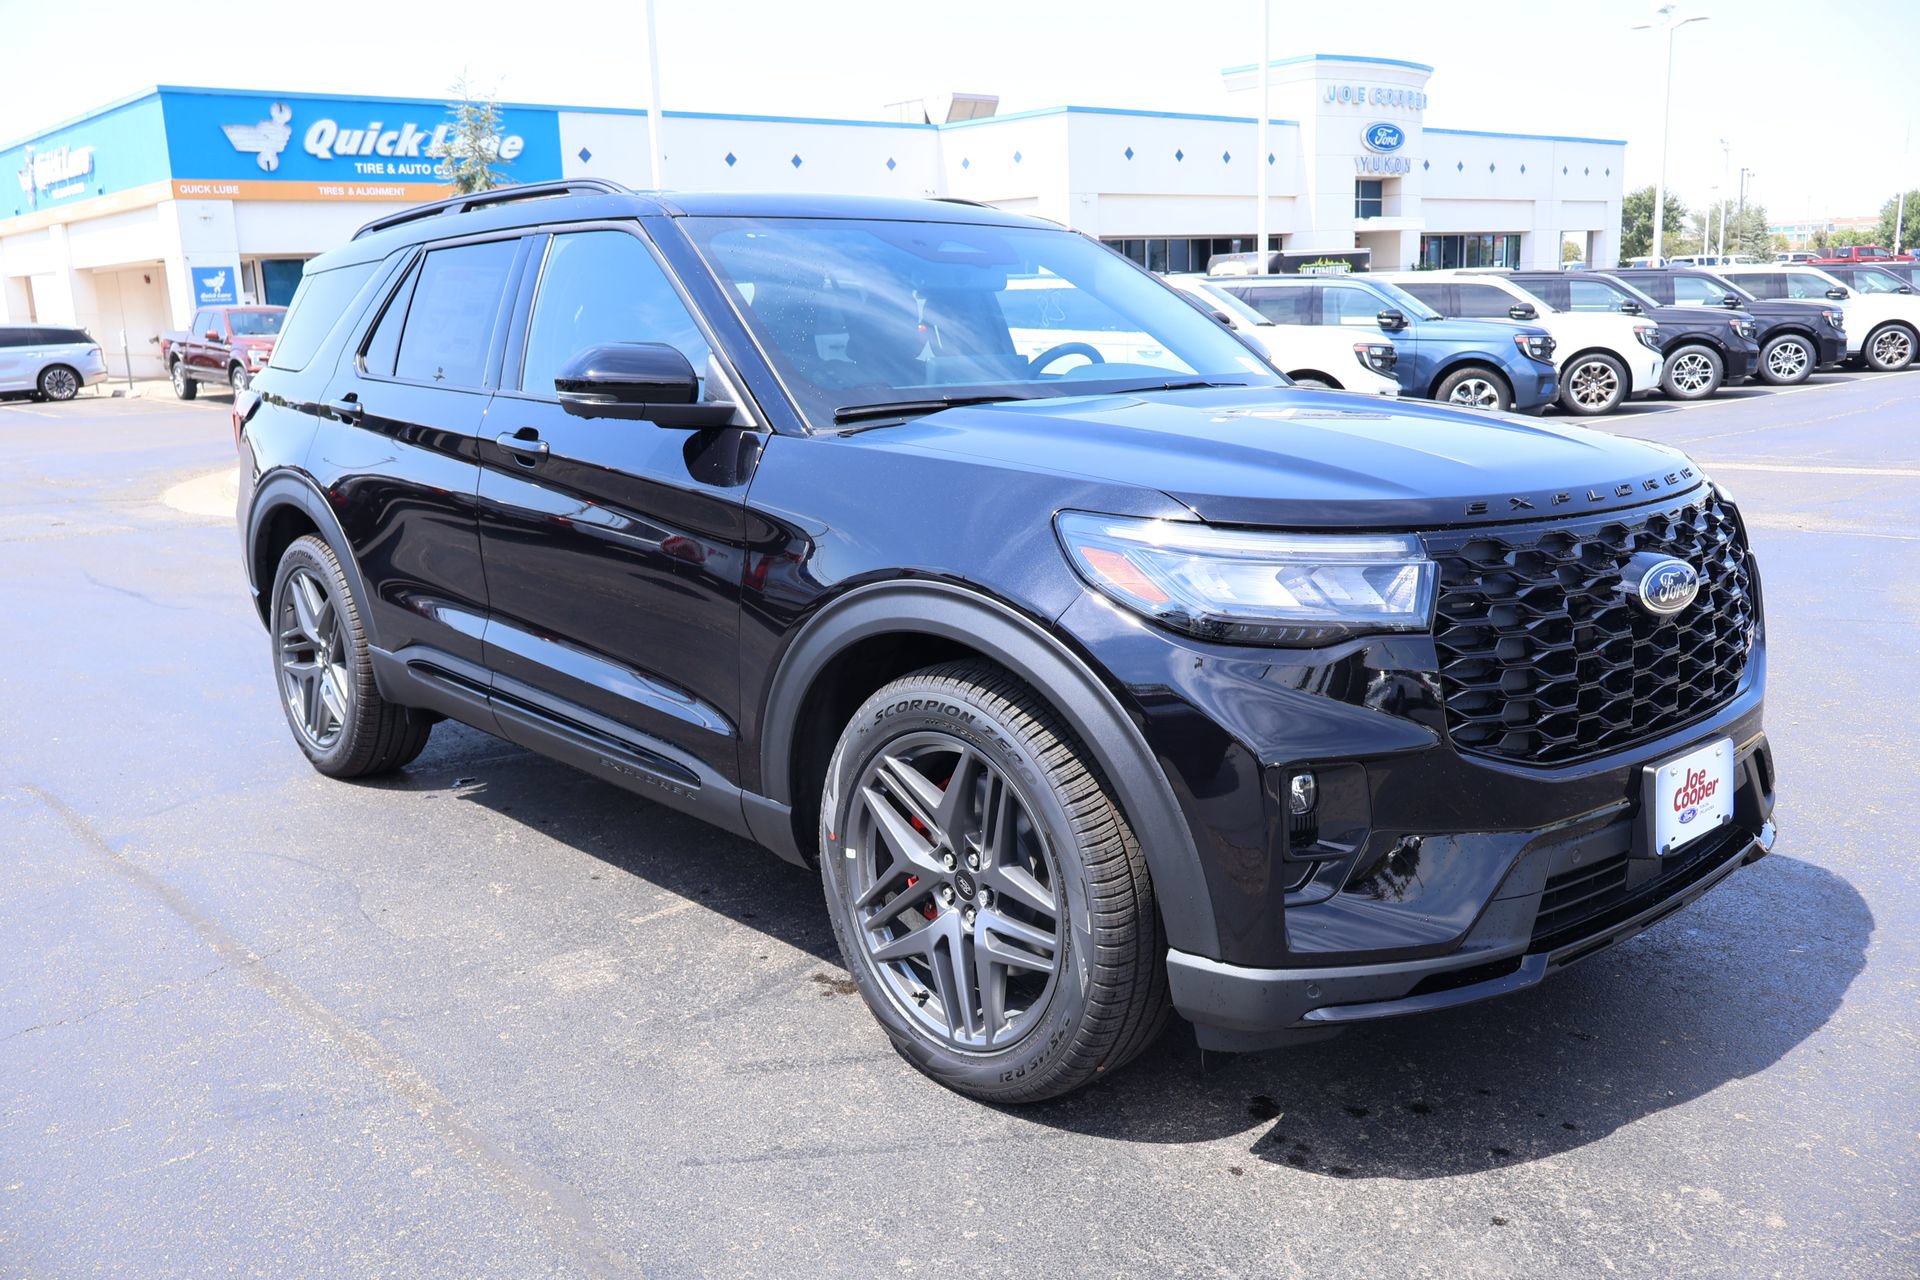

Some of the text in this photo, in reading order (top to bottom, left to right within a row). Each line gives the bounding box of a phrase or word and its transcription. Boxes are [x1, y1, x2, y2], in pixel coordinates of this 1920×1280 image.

[304, 118, 425, 160] Quick
[354, 162, 385, 174] TIRE
[387, 163, 396, 174] &
[398, 163, 431, 175] AUTO
[1358, 157, 1411, 174] YUKON
[179, 184, 240, 194] QUICK LUBE
[318, 186, 345, 196] TIRES
[355, 186, 405, 196] ALIGNMENT
[1464, 467, 1694, 516] EXPLORER
[1660, 571, 1693, 602] Ford
[873, 699, 1038, 786] SCORPION ZERO
[1683, 768, 1706, 792] Joe
[1674, 778, 1719, 812] Cooper
